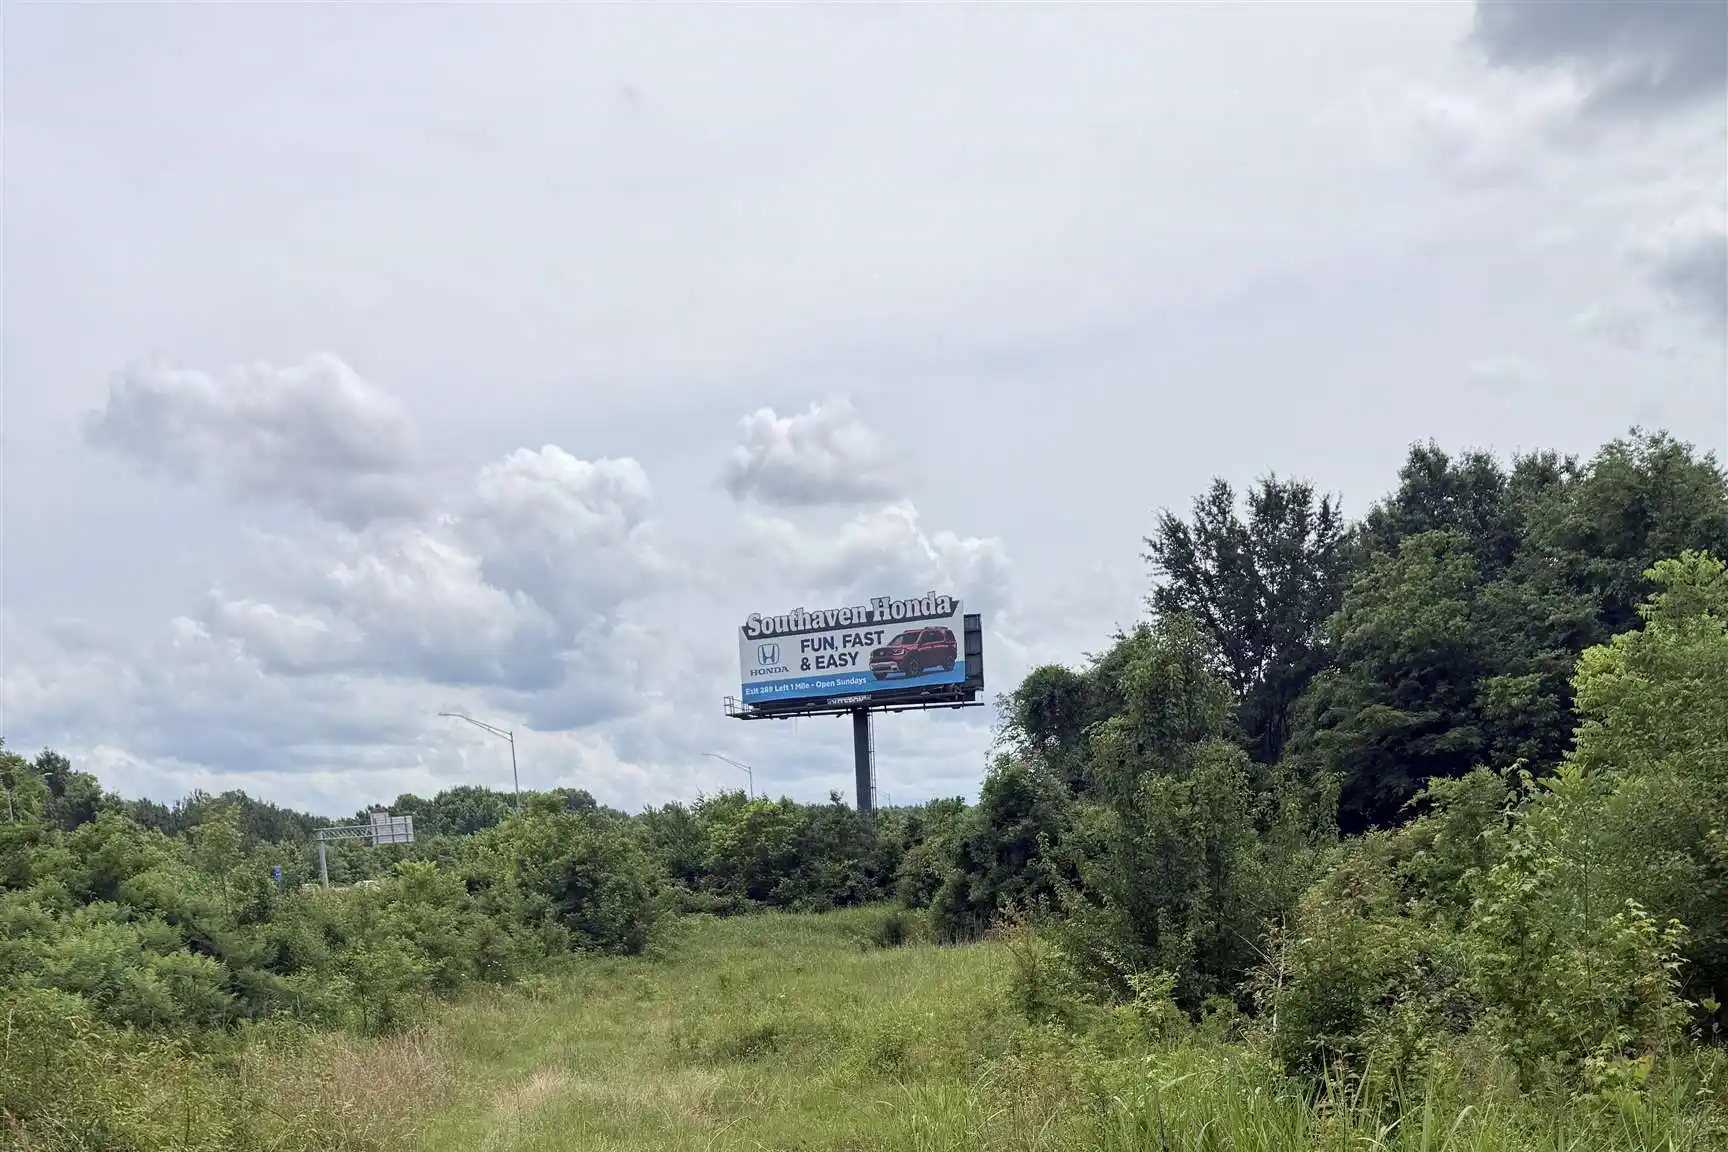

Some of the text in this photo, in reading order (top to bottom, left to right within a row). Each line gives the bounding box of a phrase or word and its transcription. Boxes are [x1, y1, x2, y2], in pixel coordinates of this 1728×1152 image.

[747, 591, 952, 636] Southaven Honda
[800, 630, 885, 654] FUN, FAST
[800, 651, 859, 671] & EASY
[750, 666, 790, 677] HONDA
[774, 684, 789, 692] Left
[795, 682, 810, 690] Mile
[816, 680, 835, 688] Open
[836, 677, 867, 686] Sundays
